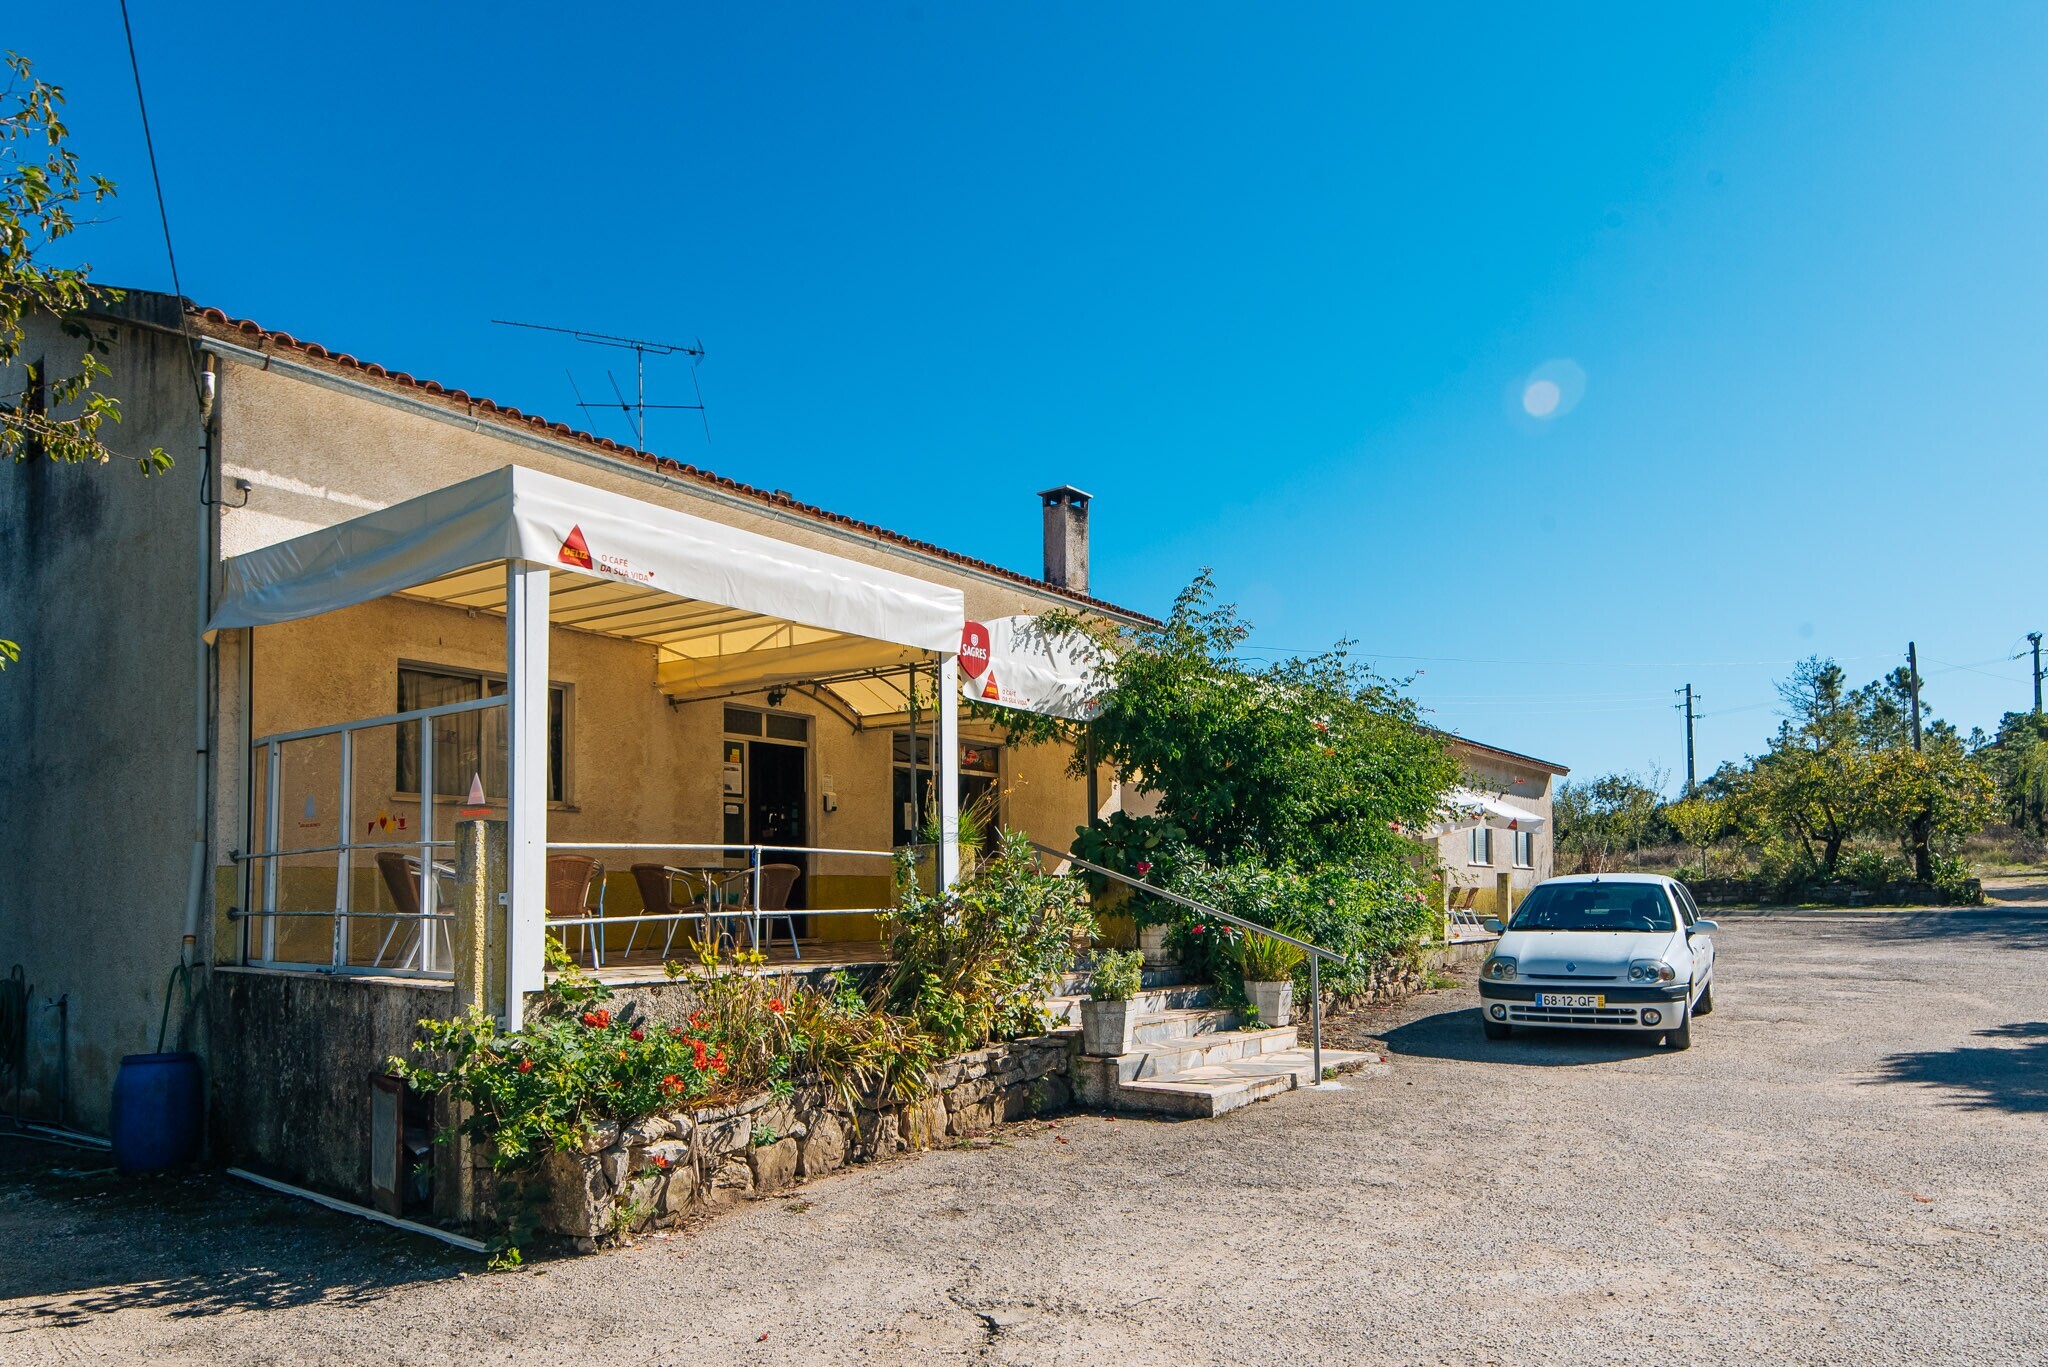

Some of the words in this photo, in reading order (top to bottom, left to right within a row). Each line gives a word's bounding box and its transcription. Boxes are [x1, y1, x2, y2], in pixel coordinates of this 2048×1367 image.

[564, 547, 588, 559] DELTA
[601, 554, 607, 562] O
[600, 564, 612, 573] DA
[613, 567, 629, 578] SUA
[630, 571, 649, 582] VIDA
[962, 643, 986, 660] SAGRES
